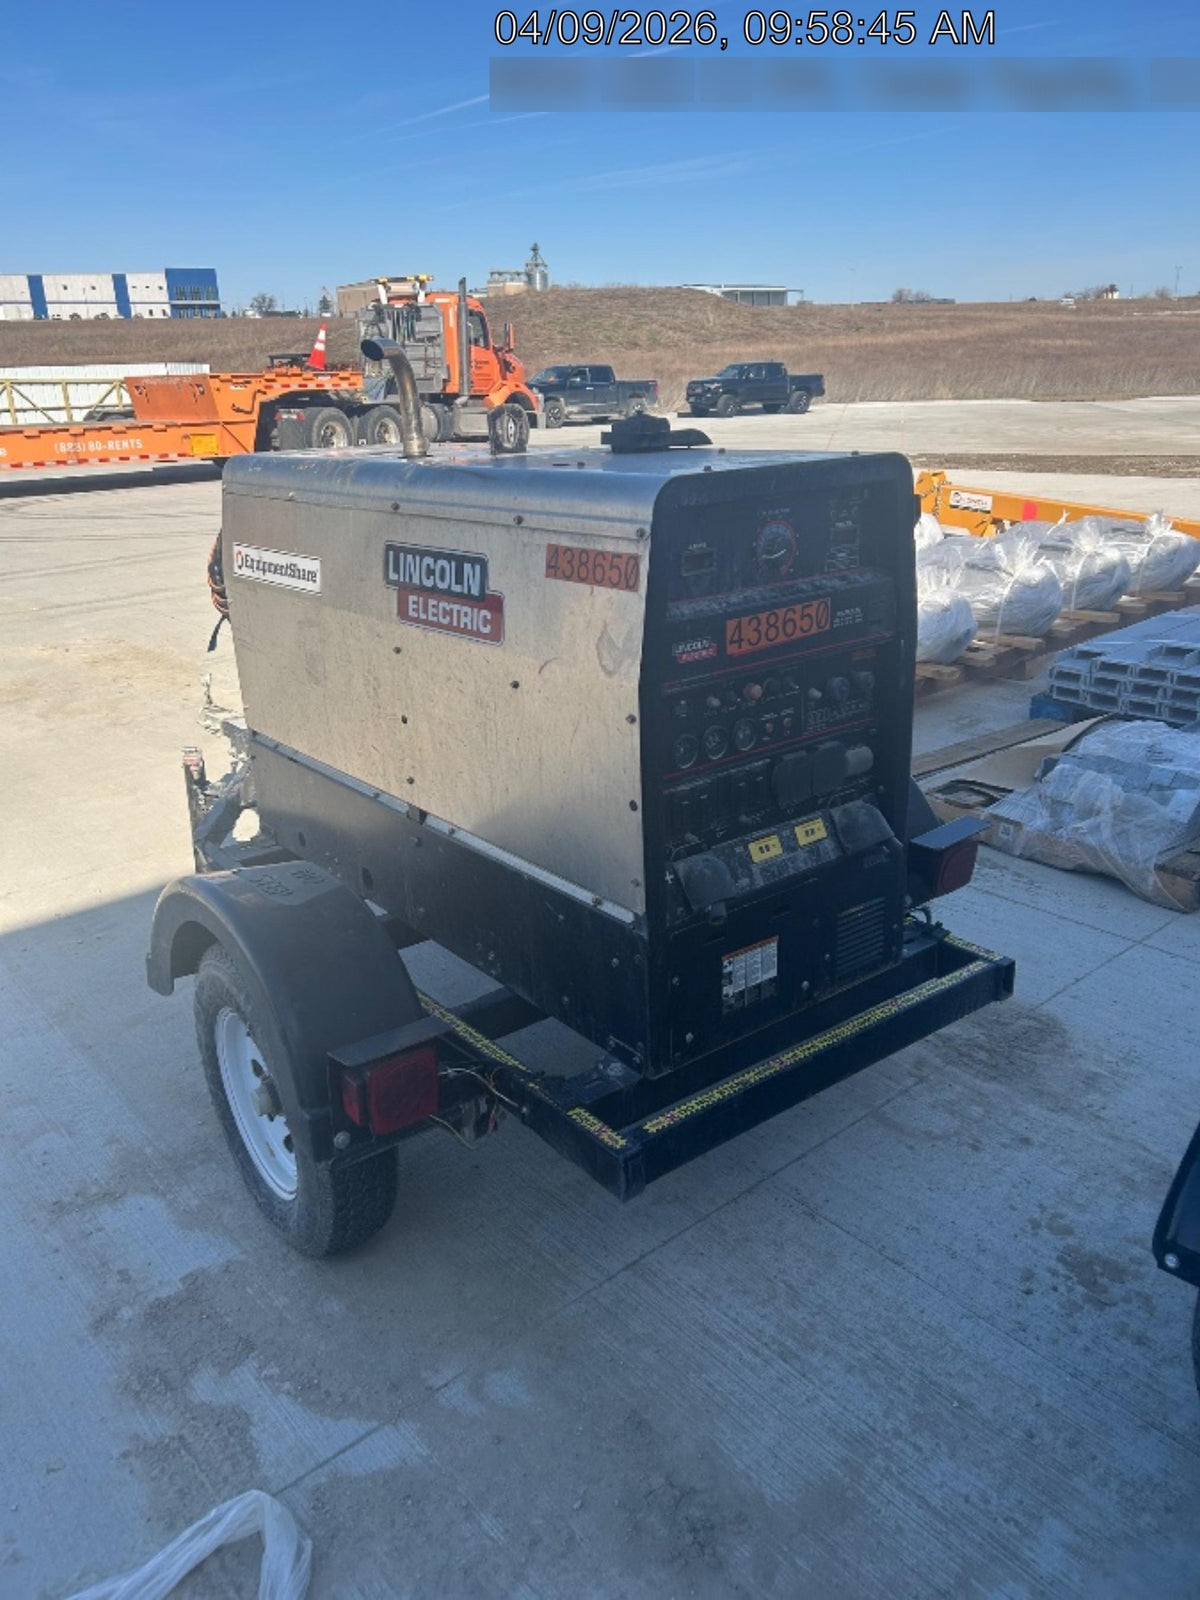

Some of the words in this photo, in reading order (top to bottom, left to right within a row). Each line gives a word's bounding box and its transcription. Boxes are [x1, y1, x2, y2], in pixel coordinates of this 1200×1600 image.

[244, 553, 317, 583] EquipmentShare
[388, 550, 481, 597] LINCOLN
[546, 544, 640, 591] 438650
[407, 594, 493, 634] ELECTRIC
[728, 600, 831, 651] 438650
